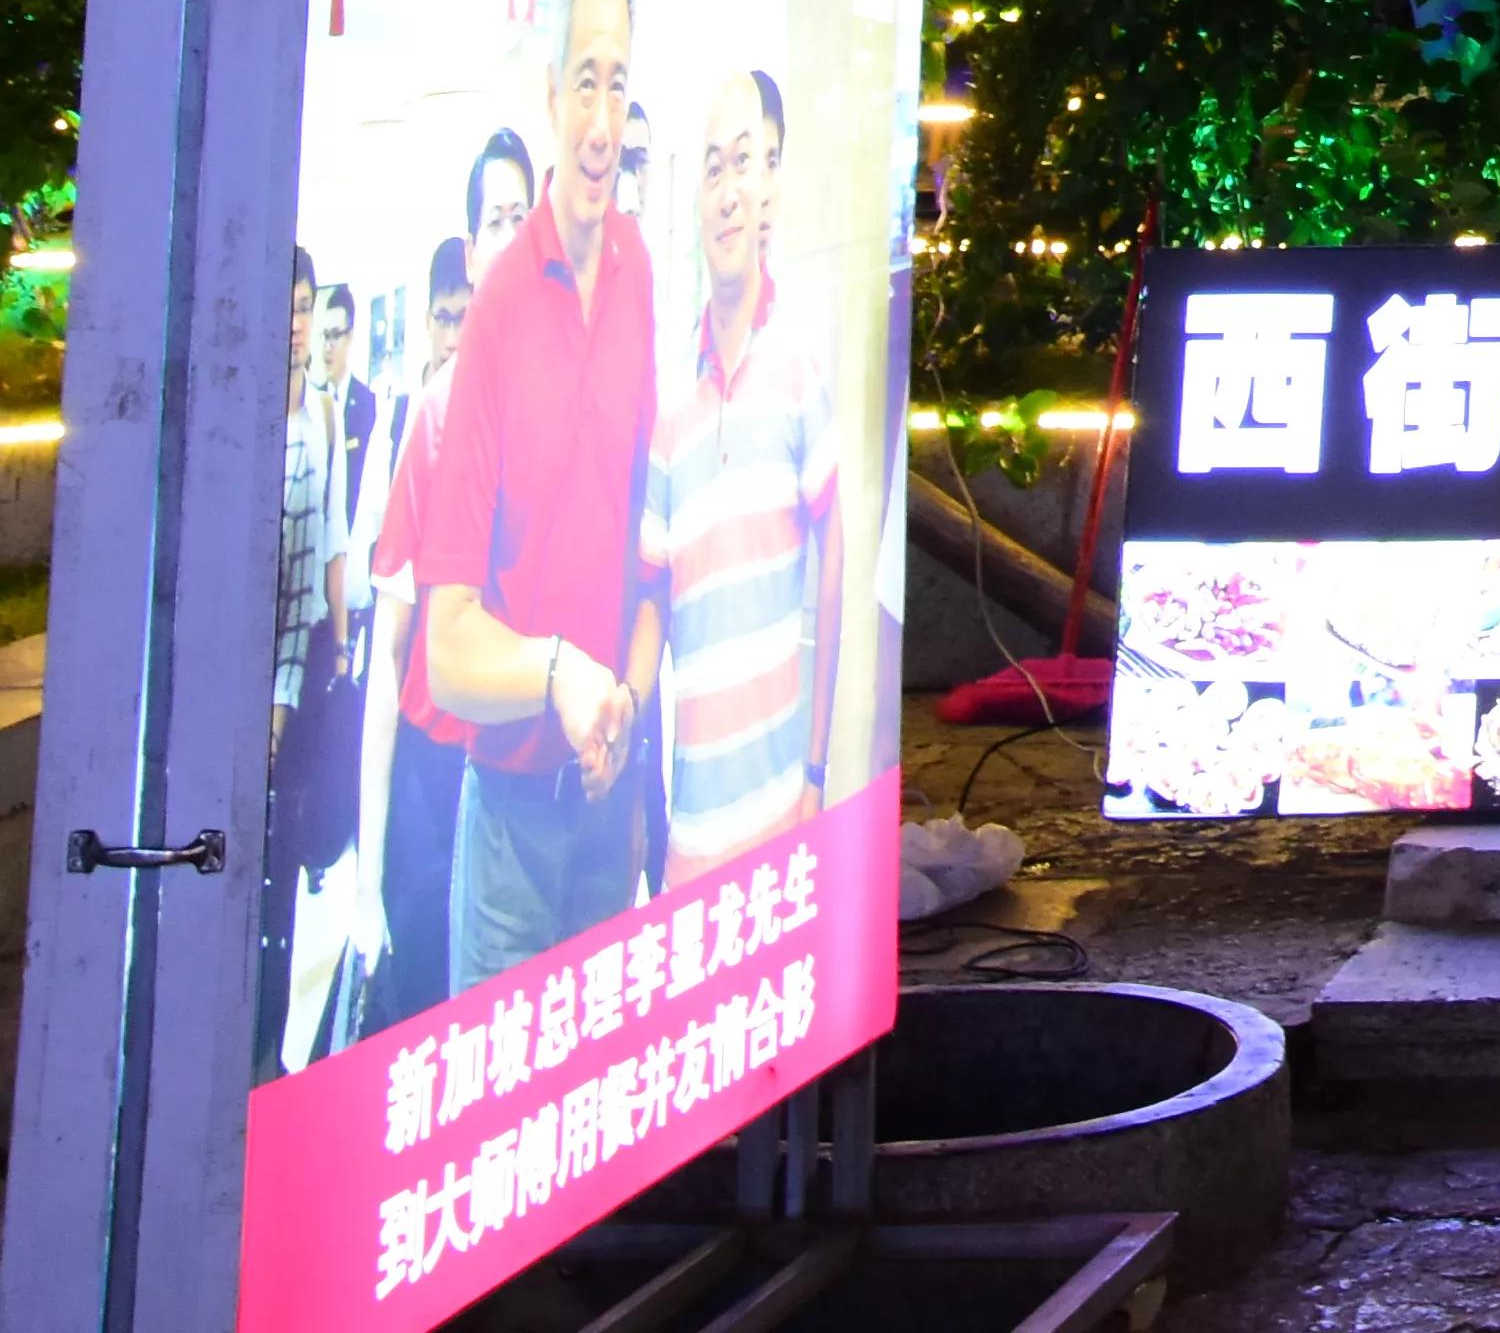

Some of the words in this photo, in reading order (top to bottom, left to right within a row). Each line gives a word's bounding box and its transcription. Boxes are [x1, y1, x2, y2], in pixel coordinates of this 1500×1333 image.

[376, 954, 816, 1301] 到大师傅用餐并友情合影
[384, 843, 818, 1154] 新加坡总理李显龙先生
